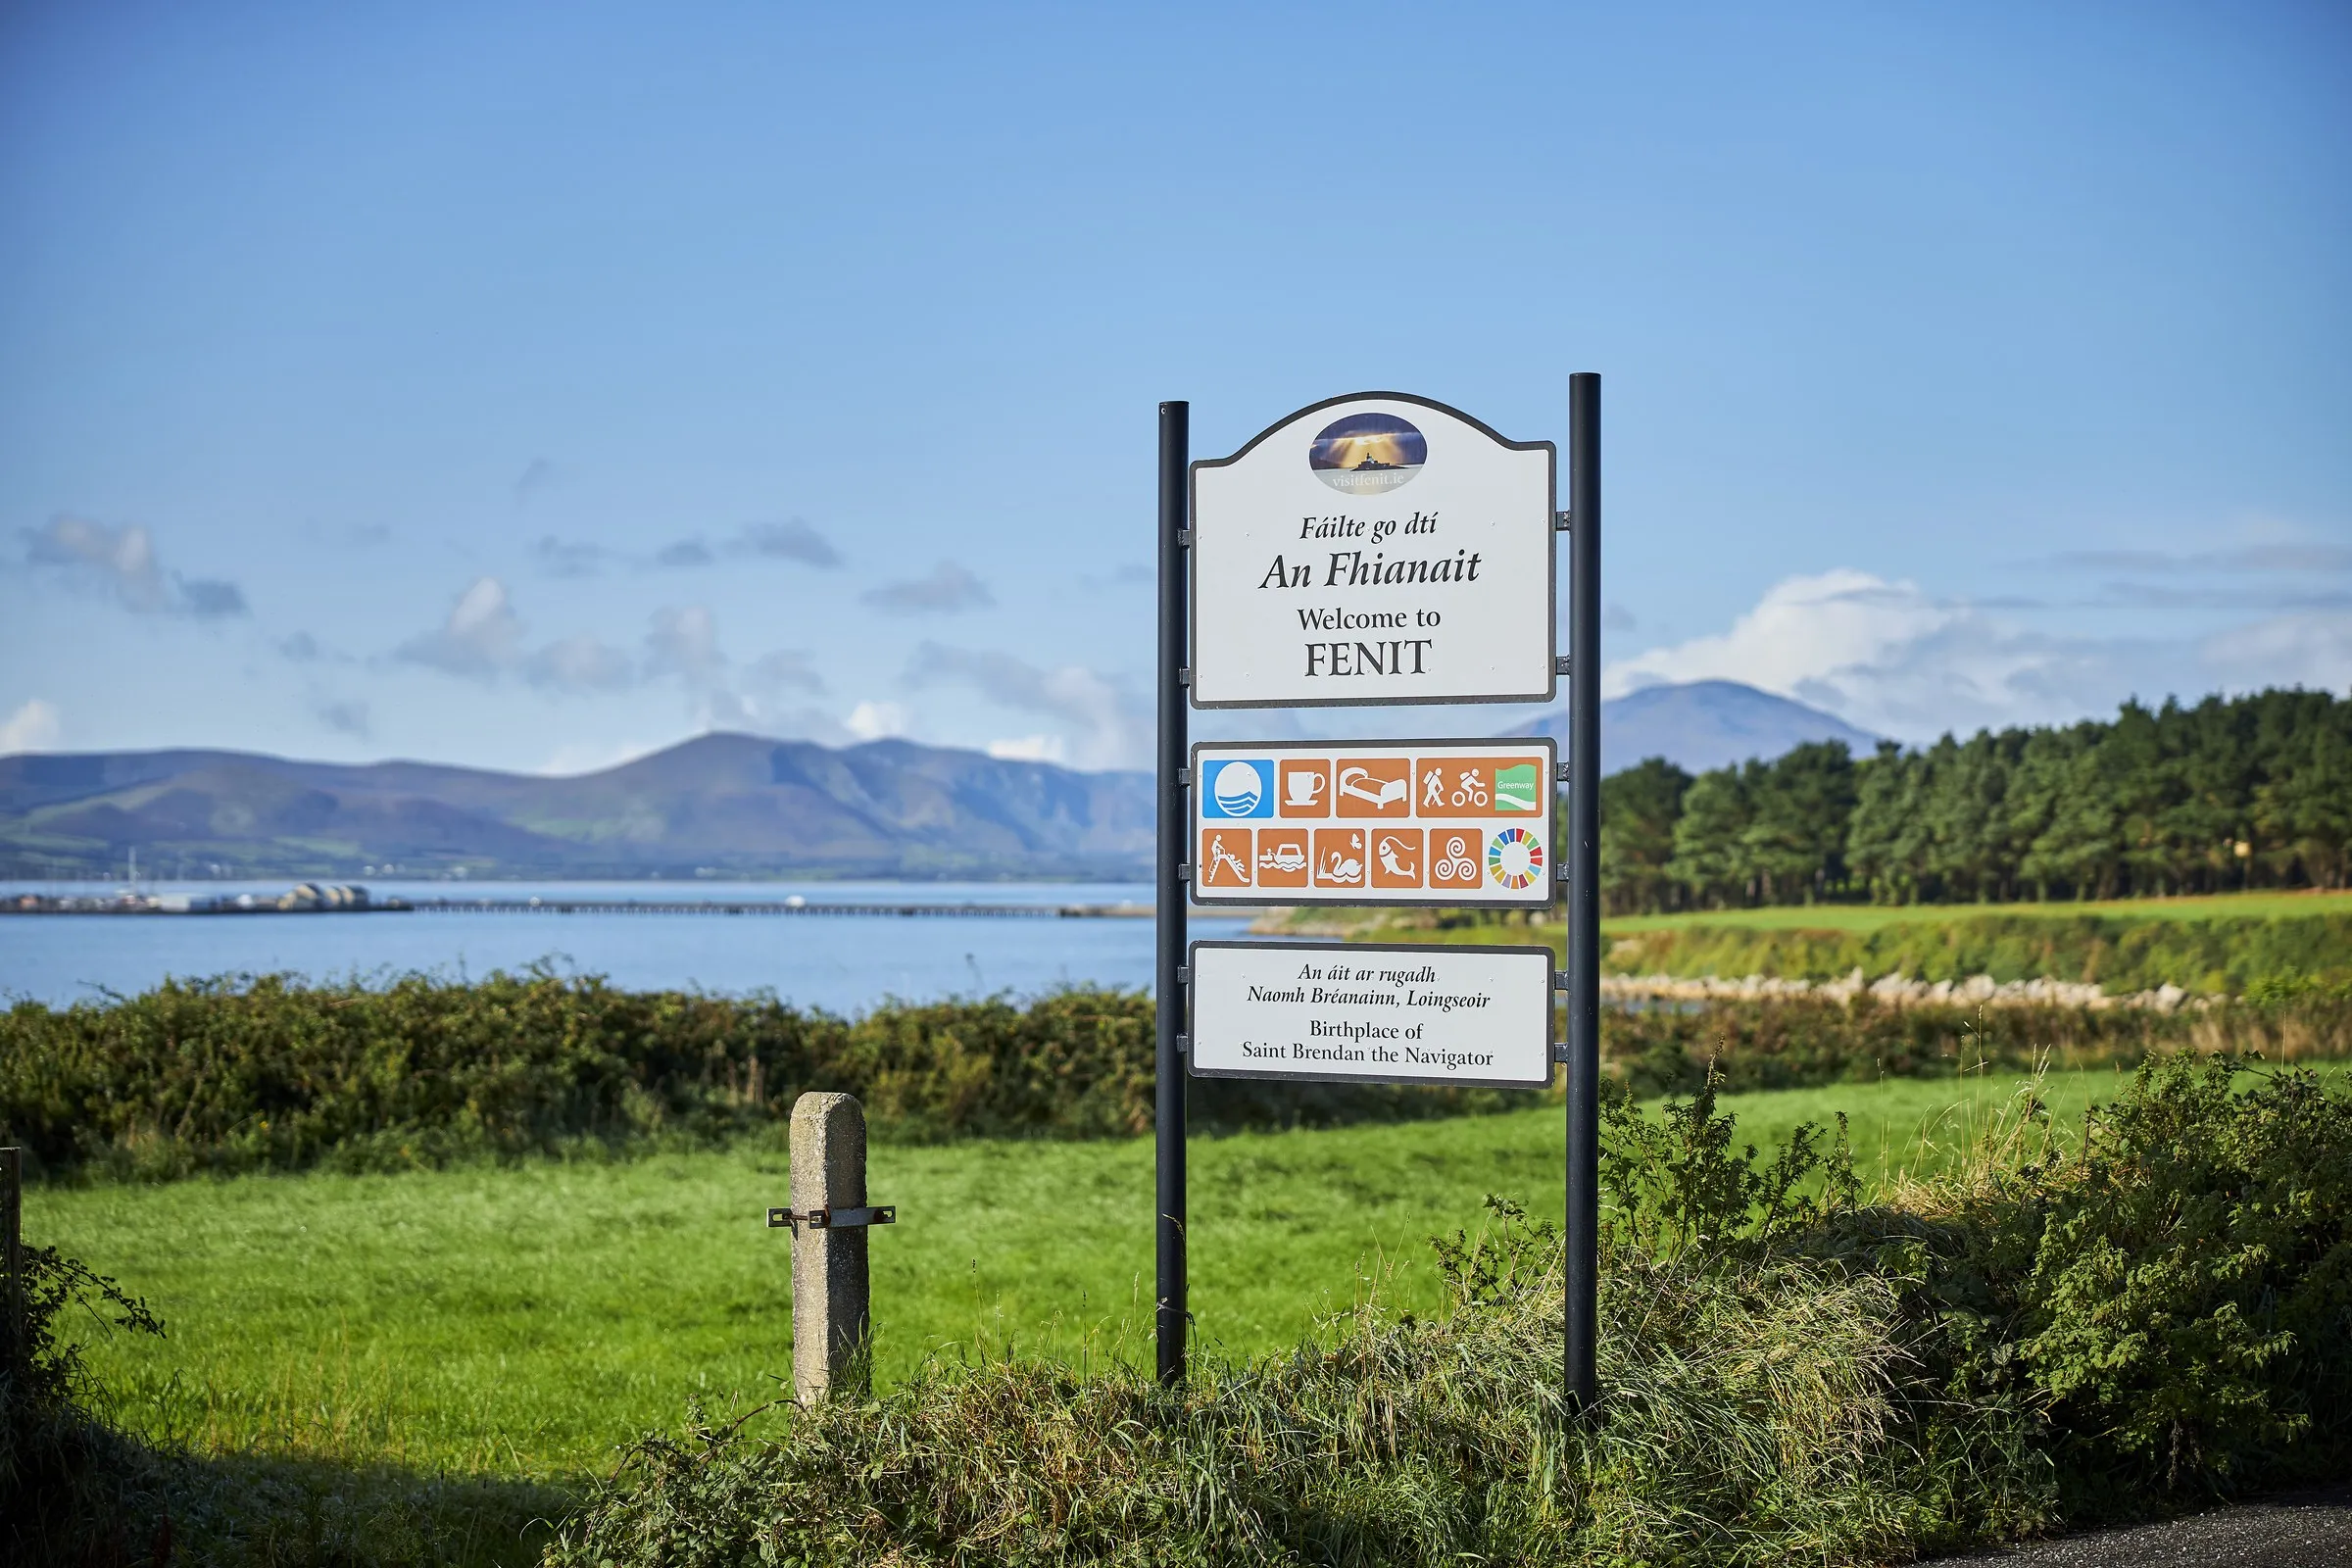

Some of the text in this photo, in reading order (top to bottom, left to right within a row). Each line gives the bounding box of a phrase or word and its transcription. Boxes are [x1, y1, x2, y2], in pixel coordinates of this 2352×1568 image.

[1332, 472, 1404, 487] visitfenit.ie
[1298, 511, 1439, 545] Fáilte go dtí
[1257, 548, 1483, 590] An Fhianait
[1296, 607, 1442, 631] Welcome to
[1303, 638, 1433, 677] FENIT
[1497, 780, 1535, 791] Greenway
[1297, 963, 1436, 988] An áit ar rugadh
[1247, 985, 1491, 1013] Naomh Bréanainn, Loingseoir
[1309, 1019, 1424, 1044] Birthplace of
[1243, 1041, 1494, 1071] Saint Brendan the Navigator
